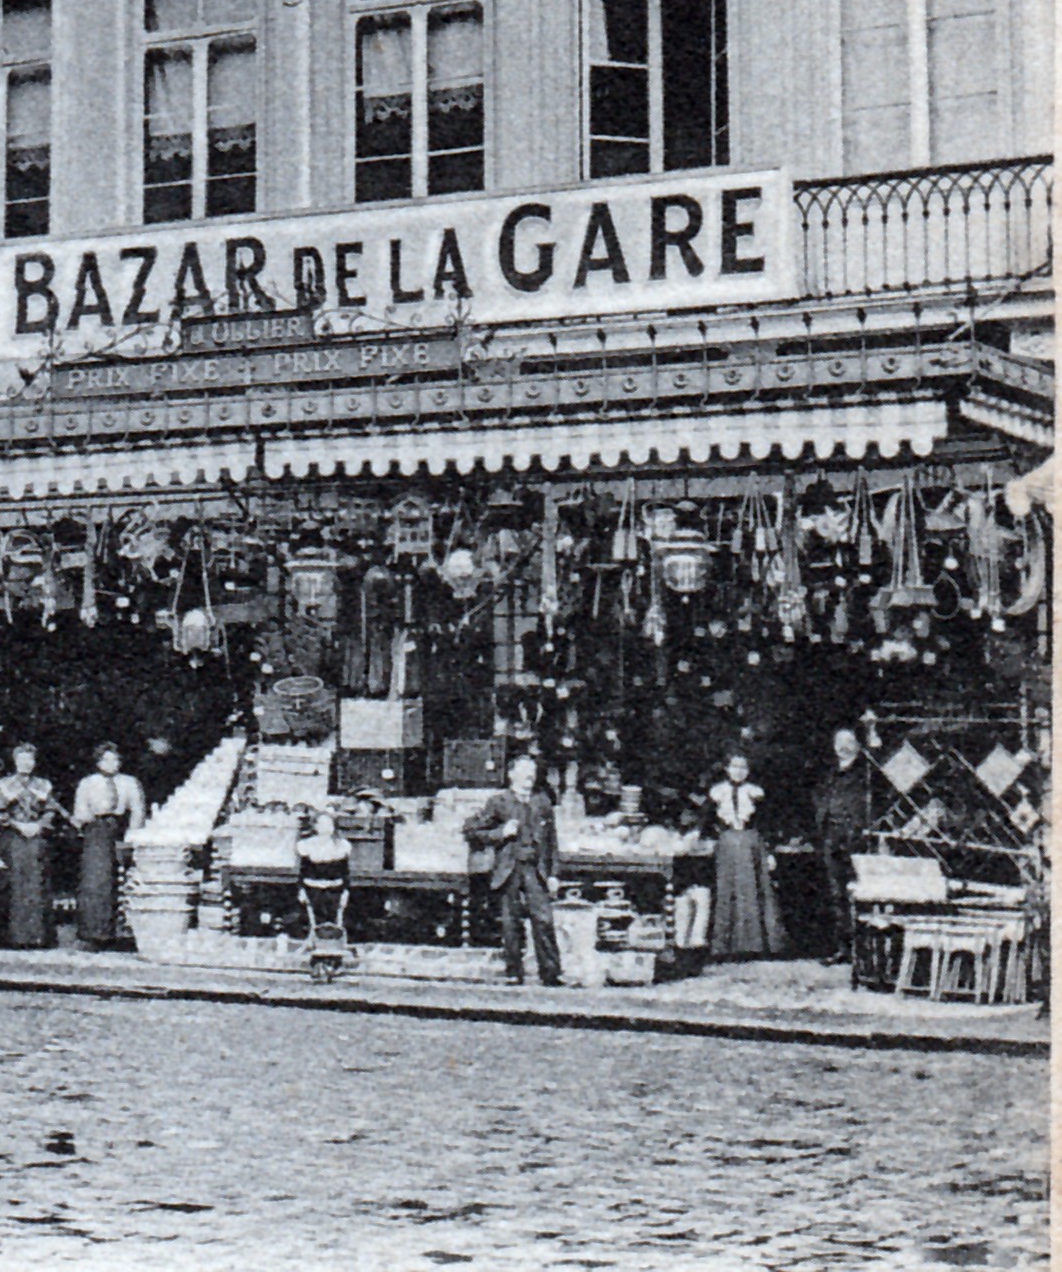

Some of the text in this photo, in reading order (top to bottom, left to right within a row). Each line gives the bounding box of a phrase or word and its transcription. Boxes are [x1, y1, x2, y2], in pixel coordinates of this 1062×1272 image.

[14, 185, 766, 334] BAZAR DE LA GARE
[67, 342, 431, 390] PRIX FIXE PRIX FIXE
